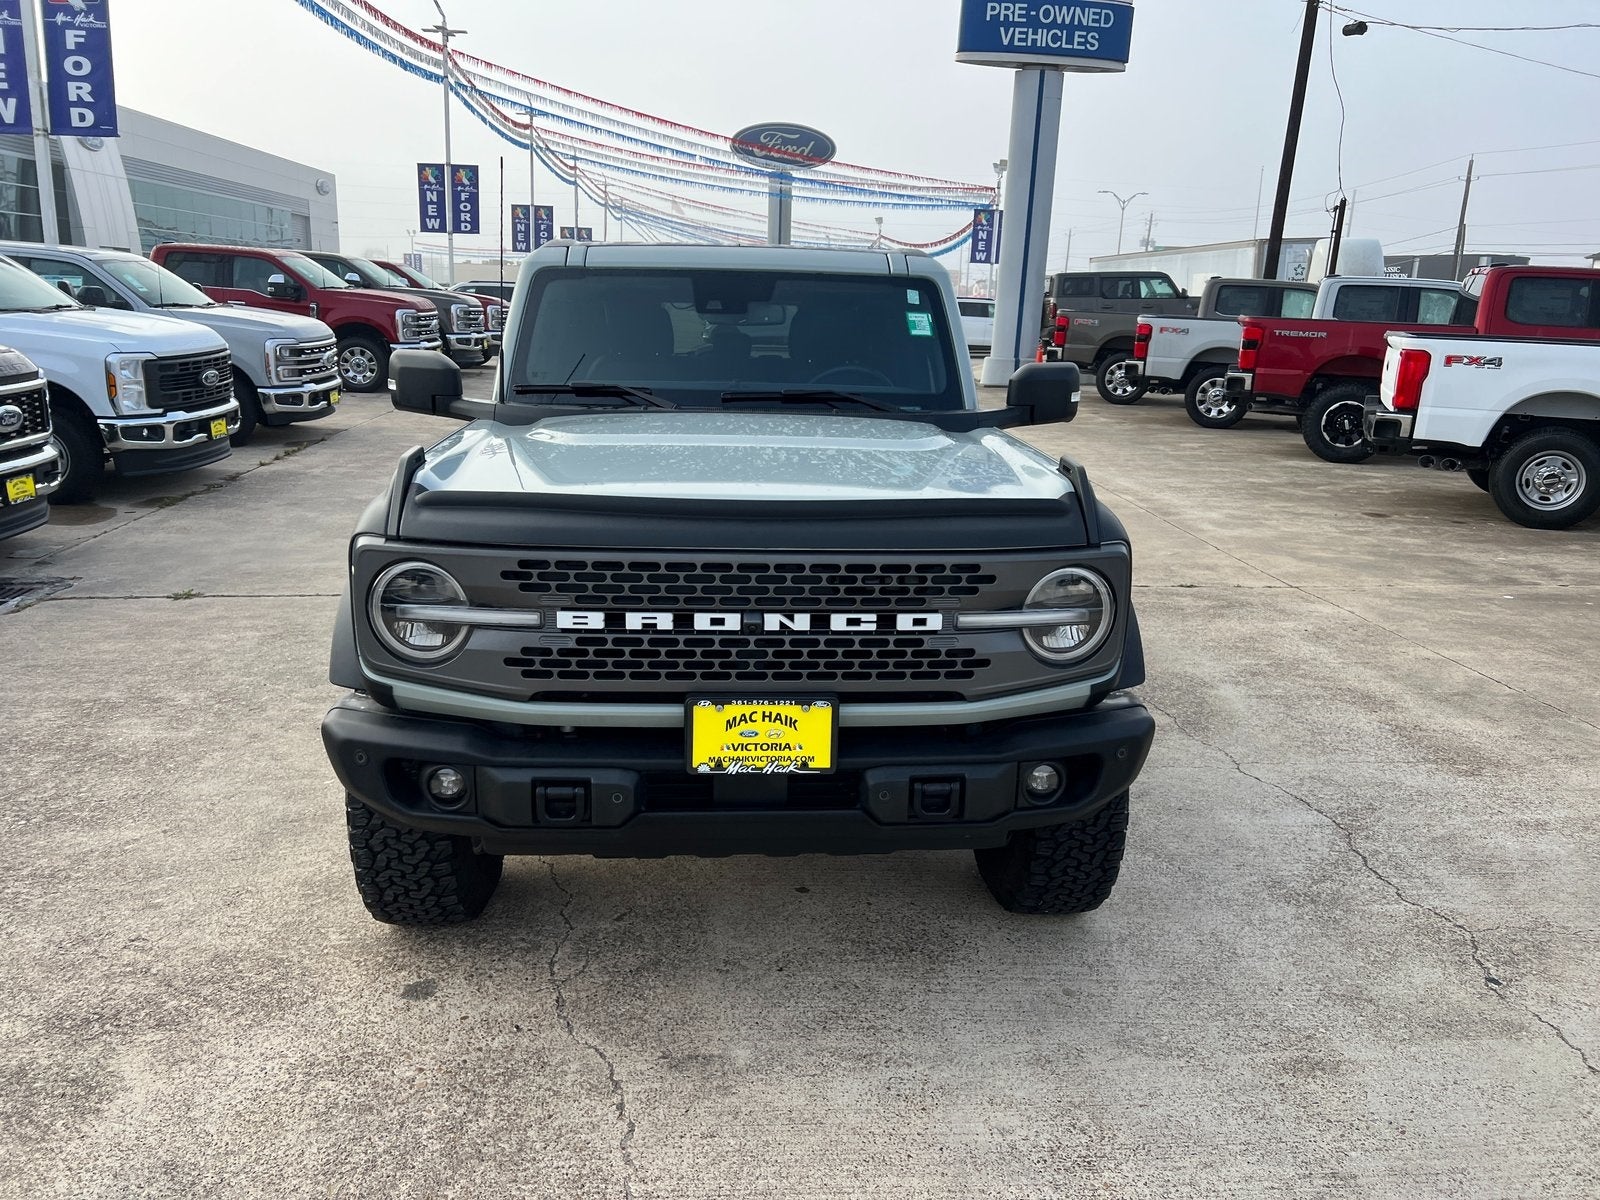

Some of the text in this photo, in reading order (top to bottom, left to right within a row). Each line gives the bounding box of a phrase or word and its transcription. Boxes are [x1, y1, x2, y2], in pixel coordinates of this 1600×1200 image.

[1000, 27, 1100, 51] VEHICLES
[63, 29, 95, 128] FORD
[425, 190, 440, 230] NEW
[459, 192, 471, 231] FORD
[516, 223, 526, 250] NEW
[540, 224, 548, 245] FOR
[975, 230, 987, 261] NEW
[1273, 329, 1328, 339] TREMOR
[1443, 354, 1503, 368] FX4
[556, 611, 943, 631] BRONCO
[725, 711, 798, 732] MAC HAIK
[731, 743, 792, 752] VICTORIA
[724, 760, 800, 775] Mac Haik
